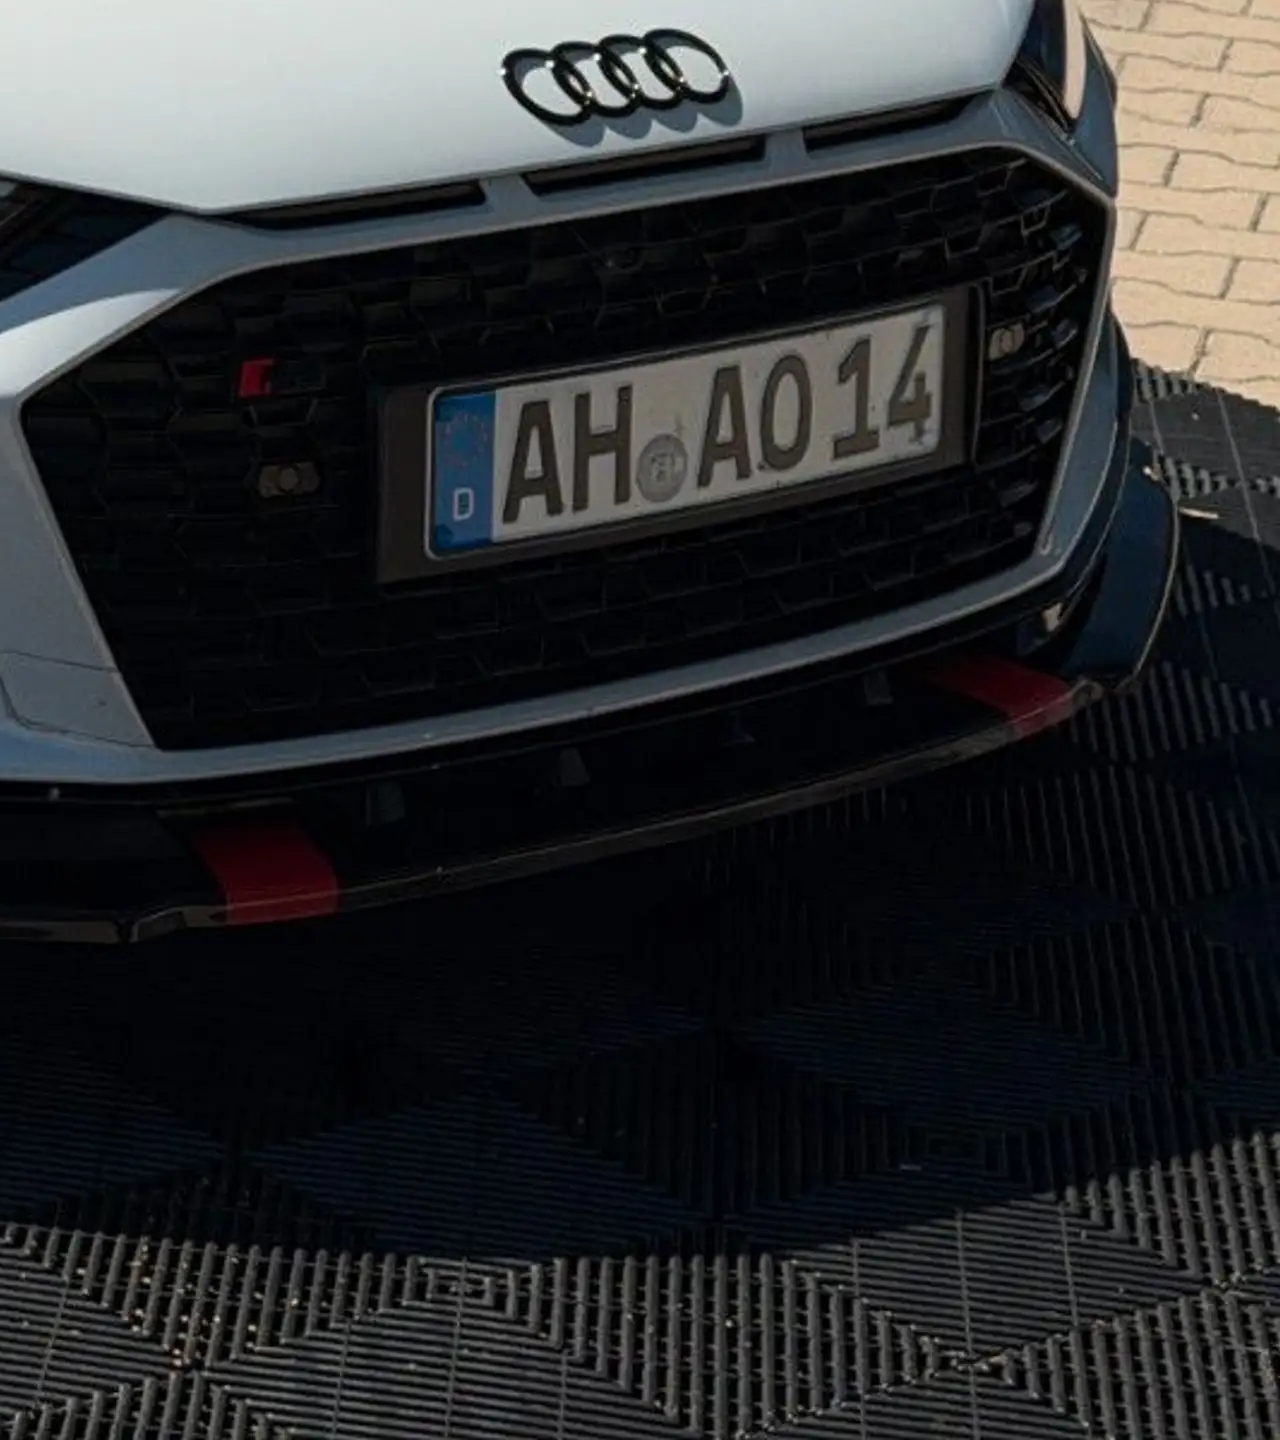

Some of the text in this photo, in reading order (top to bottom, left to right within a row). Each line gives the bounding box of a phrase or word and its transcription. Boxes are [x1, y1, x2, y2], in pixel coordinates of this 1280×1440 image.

[502, 324, 933, 525] AH AO 14
[452, 487, 475, 522] D
